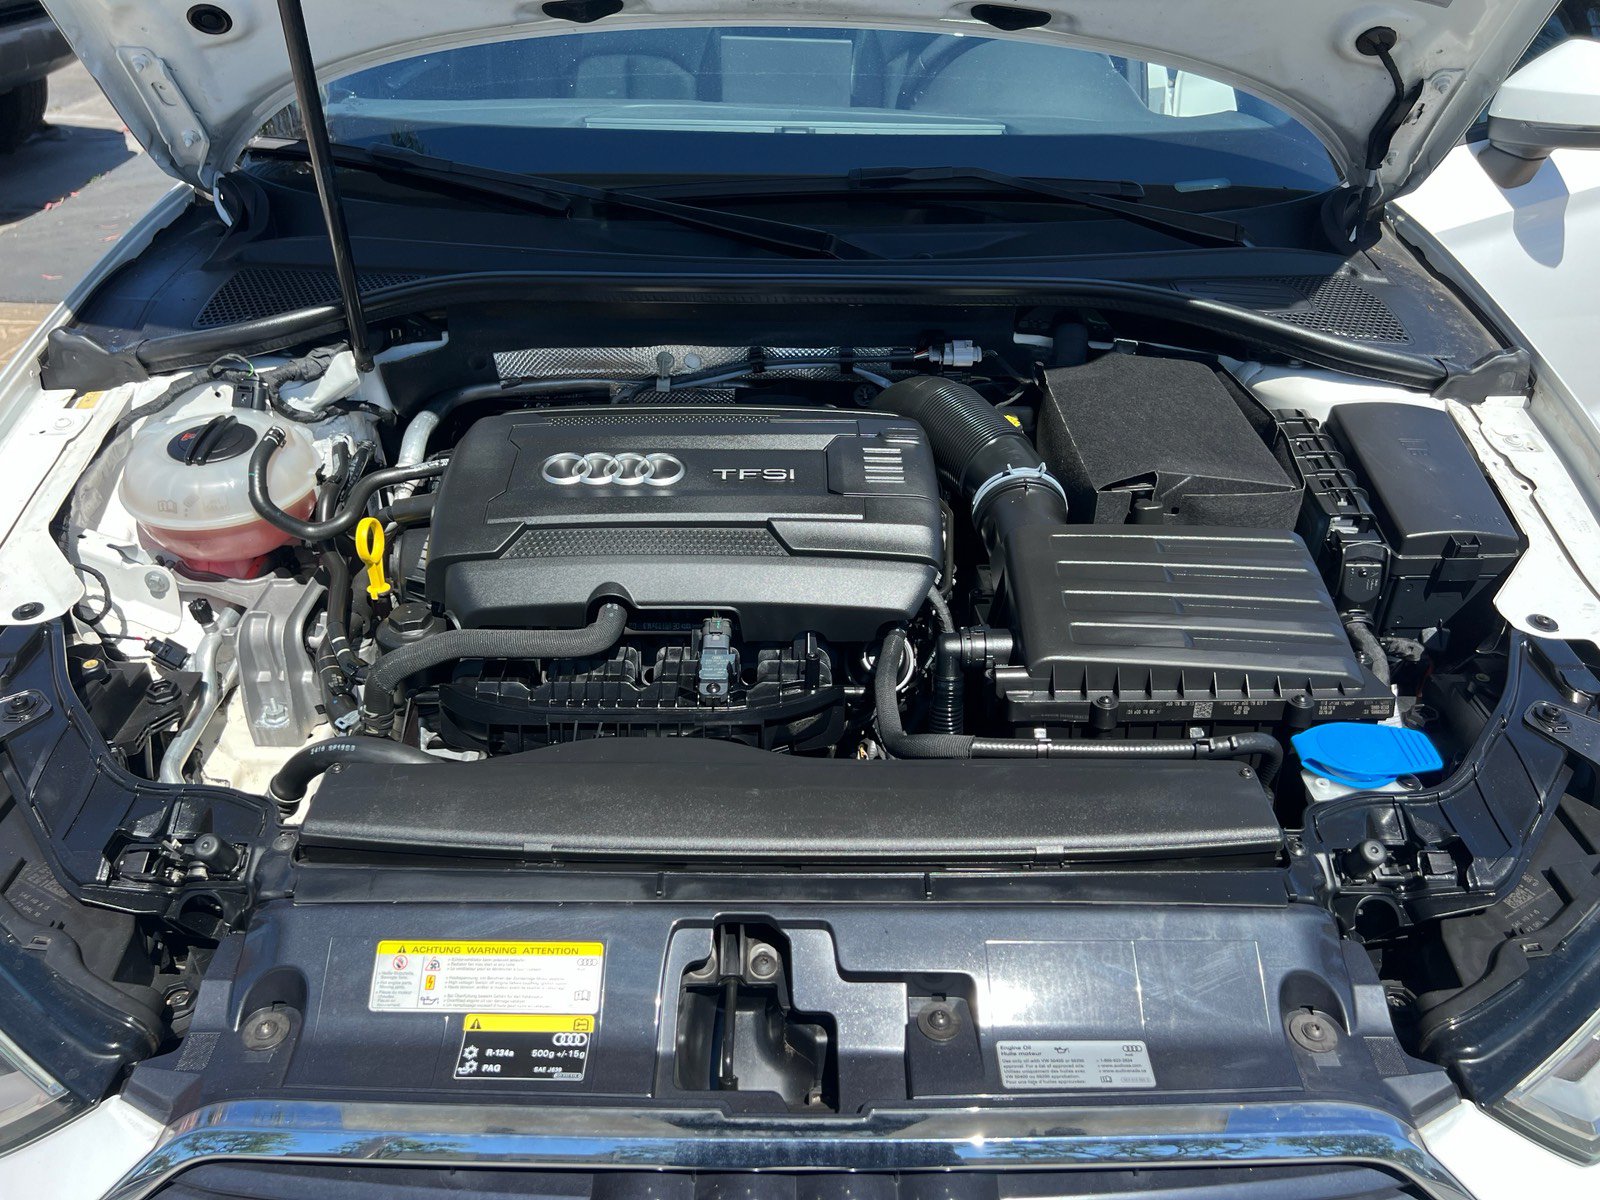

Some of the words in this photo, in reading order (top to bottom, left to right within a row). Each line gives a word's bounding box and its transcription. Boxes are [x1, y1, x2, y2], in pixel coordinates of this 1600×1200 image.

[712, 468, 796, 480] TFSI
[411, 945, 461, 954] ACHTUNG
[467, 946, 517, 955] WARNING
[522, 947, 579, 955] ATTENTION
[485, 1048, 515, 1057] R-134a
[531, 1049, 554, 1059] 500g
[481, 1064, 501, 1072] PAG
